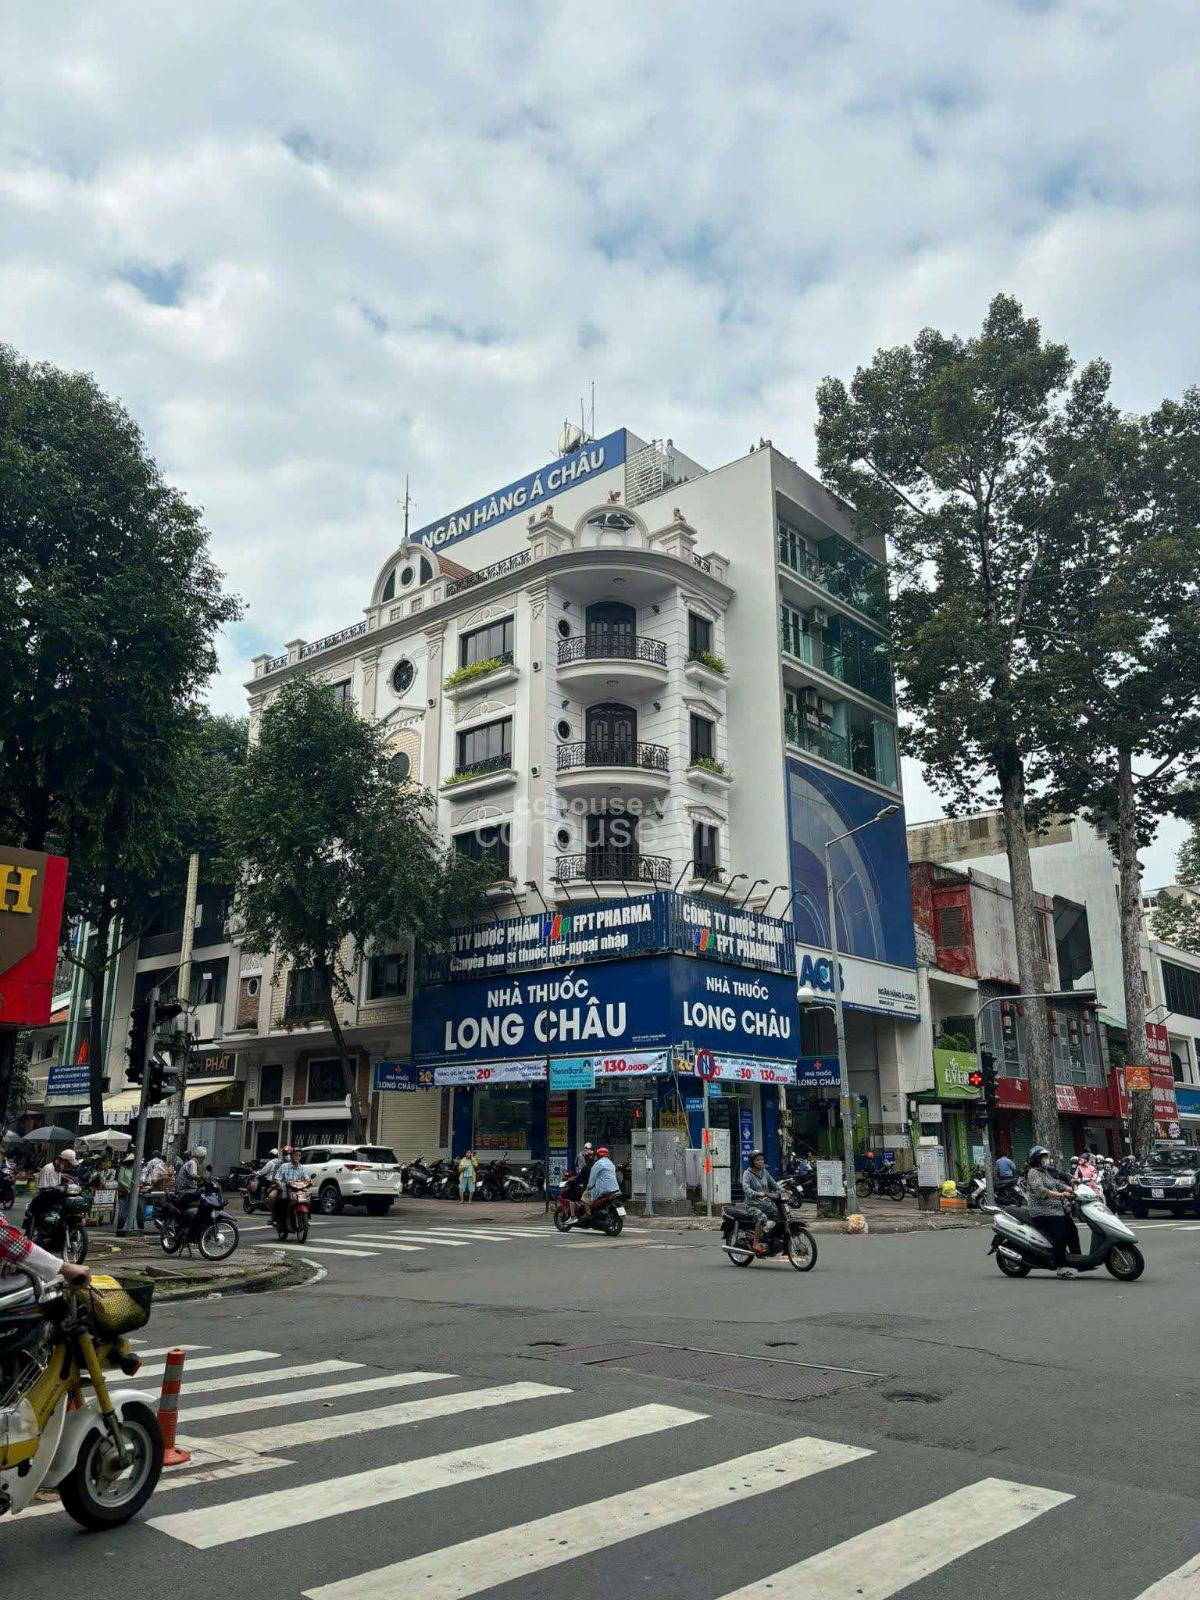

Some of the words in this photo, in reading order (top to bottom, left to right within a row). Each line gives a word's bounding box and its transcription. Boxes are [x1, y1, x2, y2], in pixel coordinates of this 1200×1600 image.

[421, 513, 472, 549] NGÂN
[474, 487, 528, 526] HÀNG
[530, 474, 544, 500] Á
[547, 447, 604, 490] CHÂU
[474, 926, 505, 950] DƯỢC
[507, 915, 540, 943] PHẨM
[573, 914, 596, 933] FPT
[597, 903, 651, 929] PHARMA
[683, 901, 711, 928] CÔNG
[714, 911, 730, 932] TY
[729, 916, 756, 937] DƯỢC
[518, 942, 547, 963] thuốc
[600, 932, 629, 951] nhập
[716, 934, 734, 954] FPT
[737, 938, 777, 963] PHARMA
[487, 981, 522, 1008] NHÀ
[528, 970, 589, 1004] THUỐC
[706, 975, 730, 995] NHÀ
[732, 978, 769, 1000] THUỐC
[799, 955, 845, 993] ACB
[445, 1013, 524, 1050] LONG
[534, 996, 626, 1043] CHÂU
[683, 1001, 736, 1031] LONG
[742, 1008, 790, 1039] CHÂU
[819, 1076, 840, 1086] CHÂU
